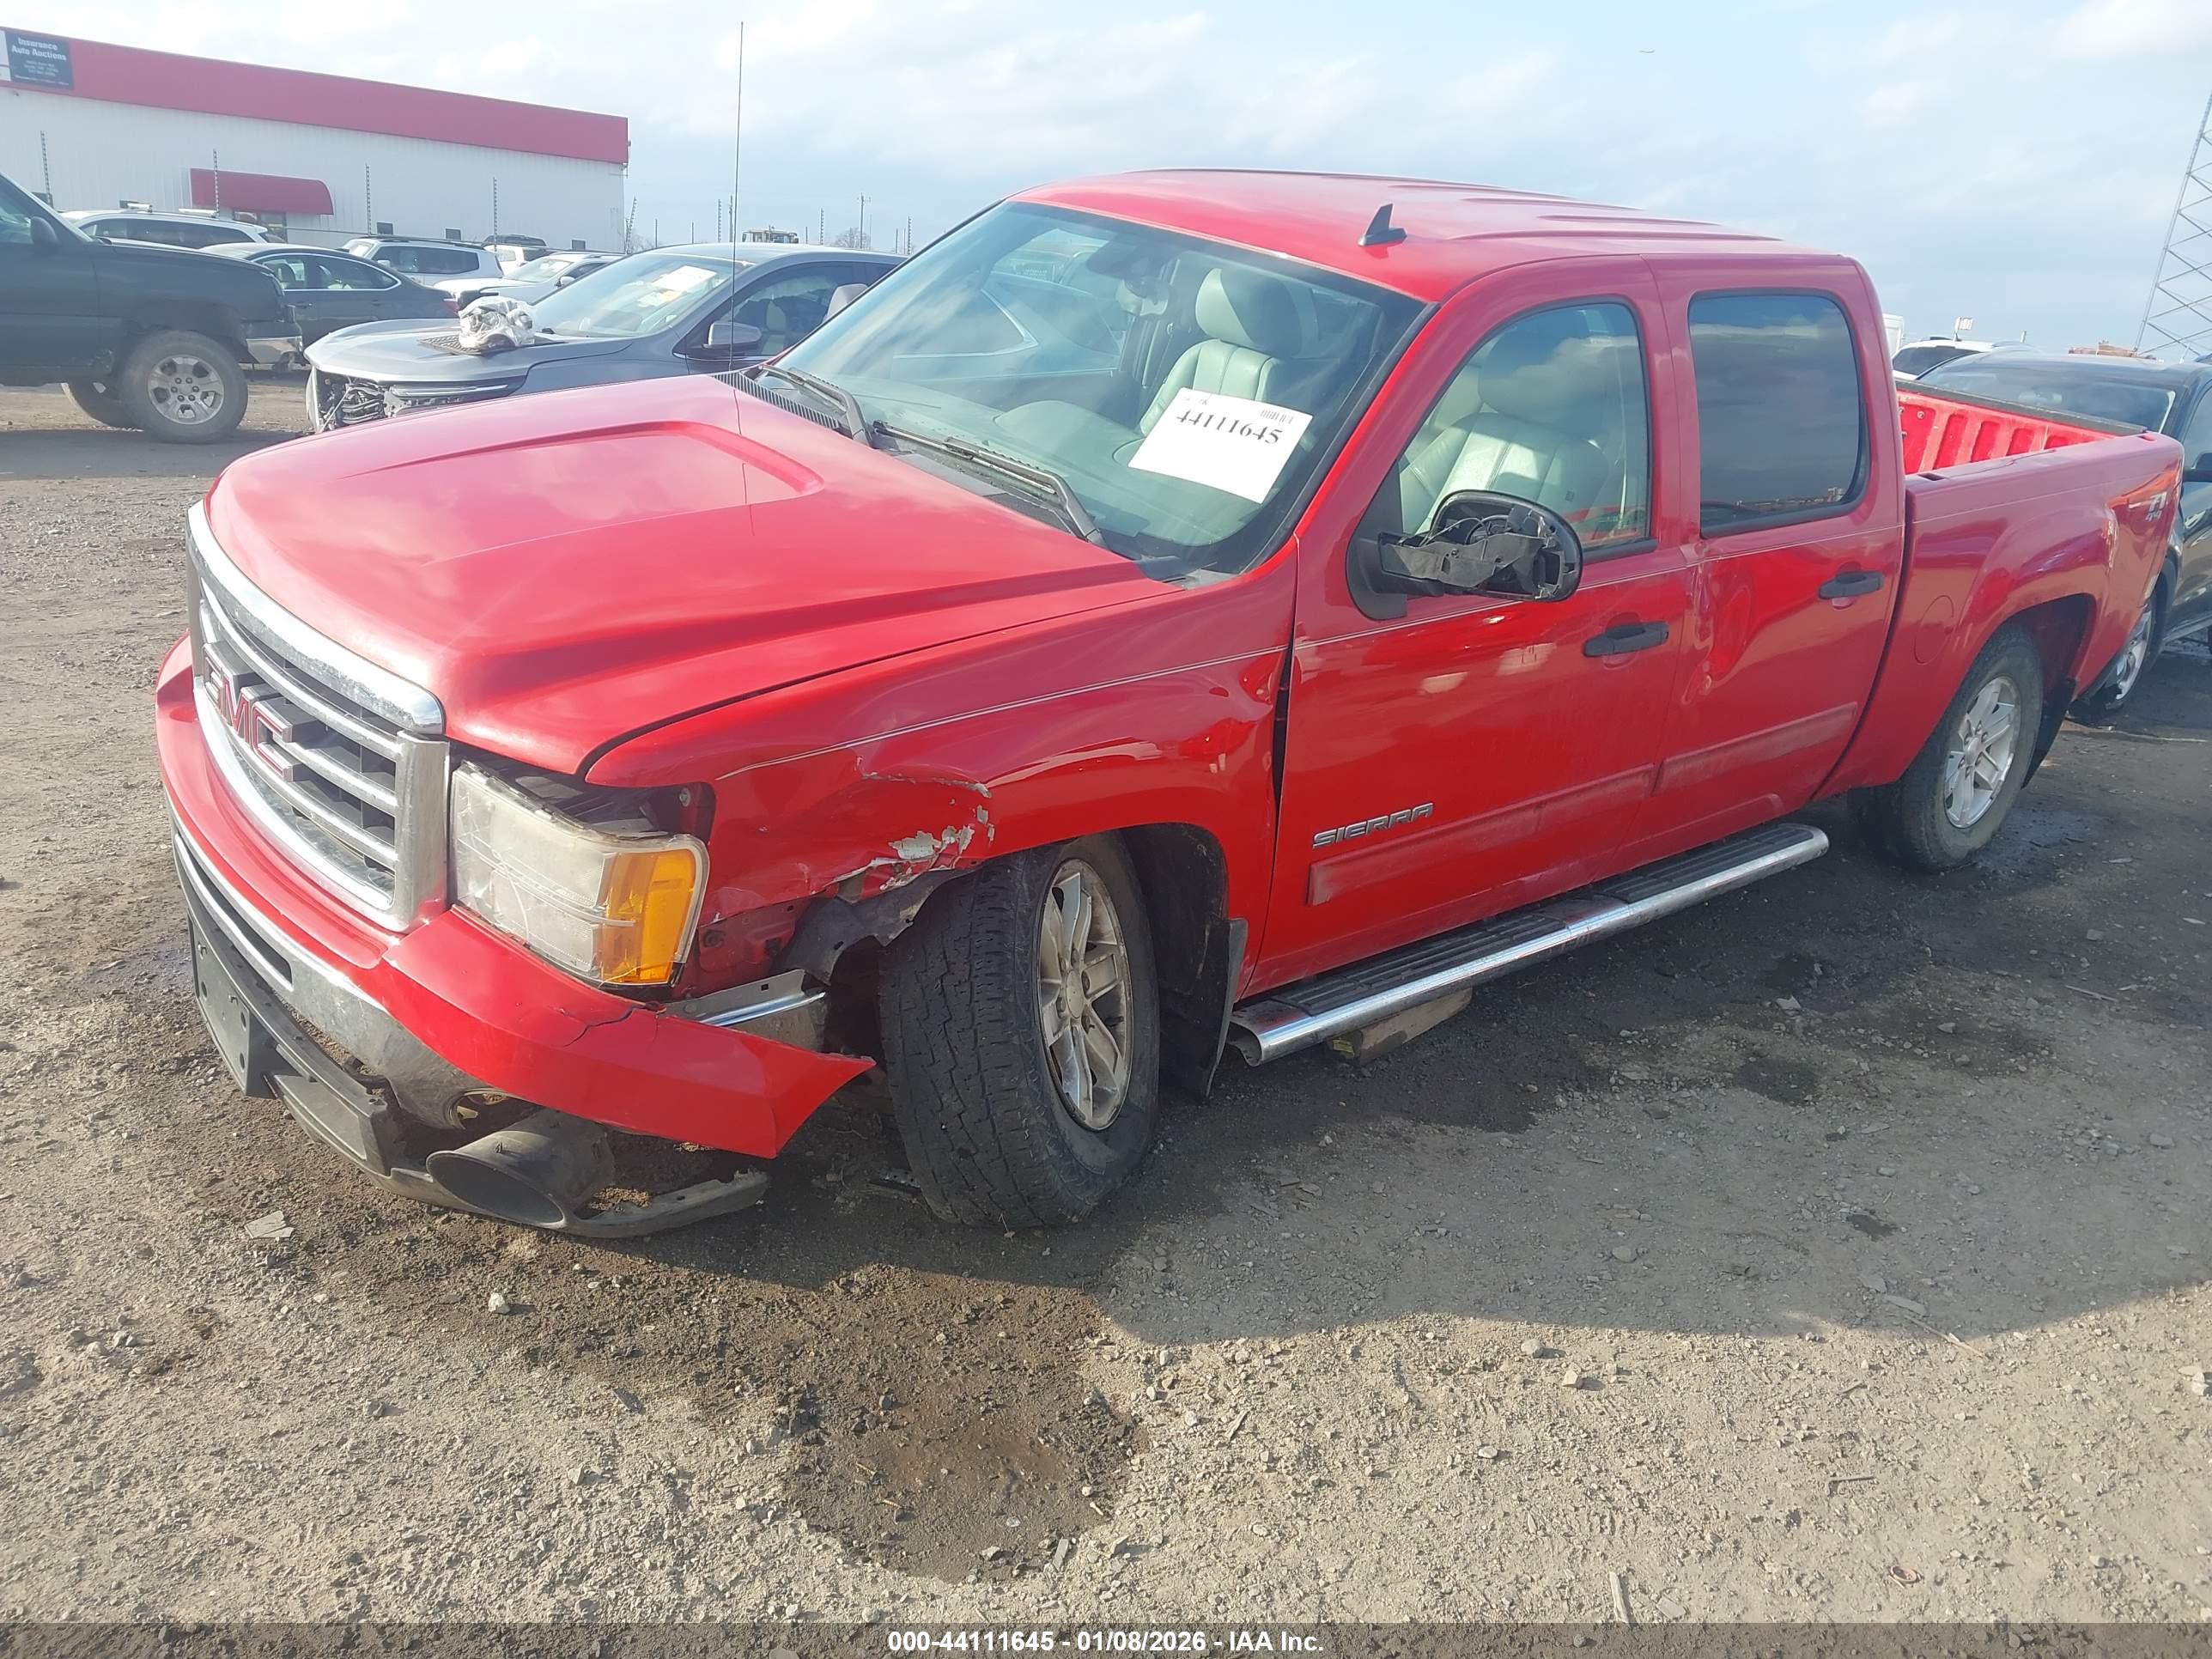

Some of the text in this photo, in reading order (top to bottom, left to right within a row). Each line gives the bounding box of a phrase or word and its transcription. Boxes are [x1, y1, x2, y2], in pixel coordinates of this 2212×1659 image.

[12, 45, 67, 60] Auto Auctions
[18, 37, 58, 51] Insurance
[1176, 410, 1283, 445] 44111645
[203, 642, 293, 782] GMC
[1312, 802, 1434, 849] SIERRA
